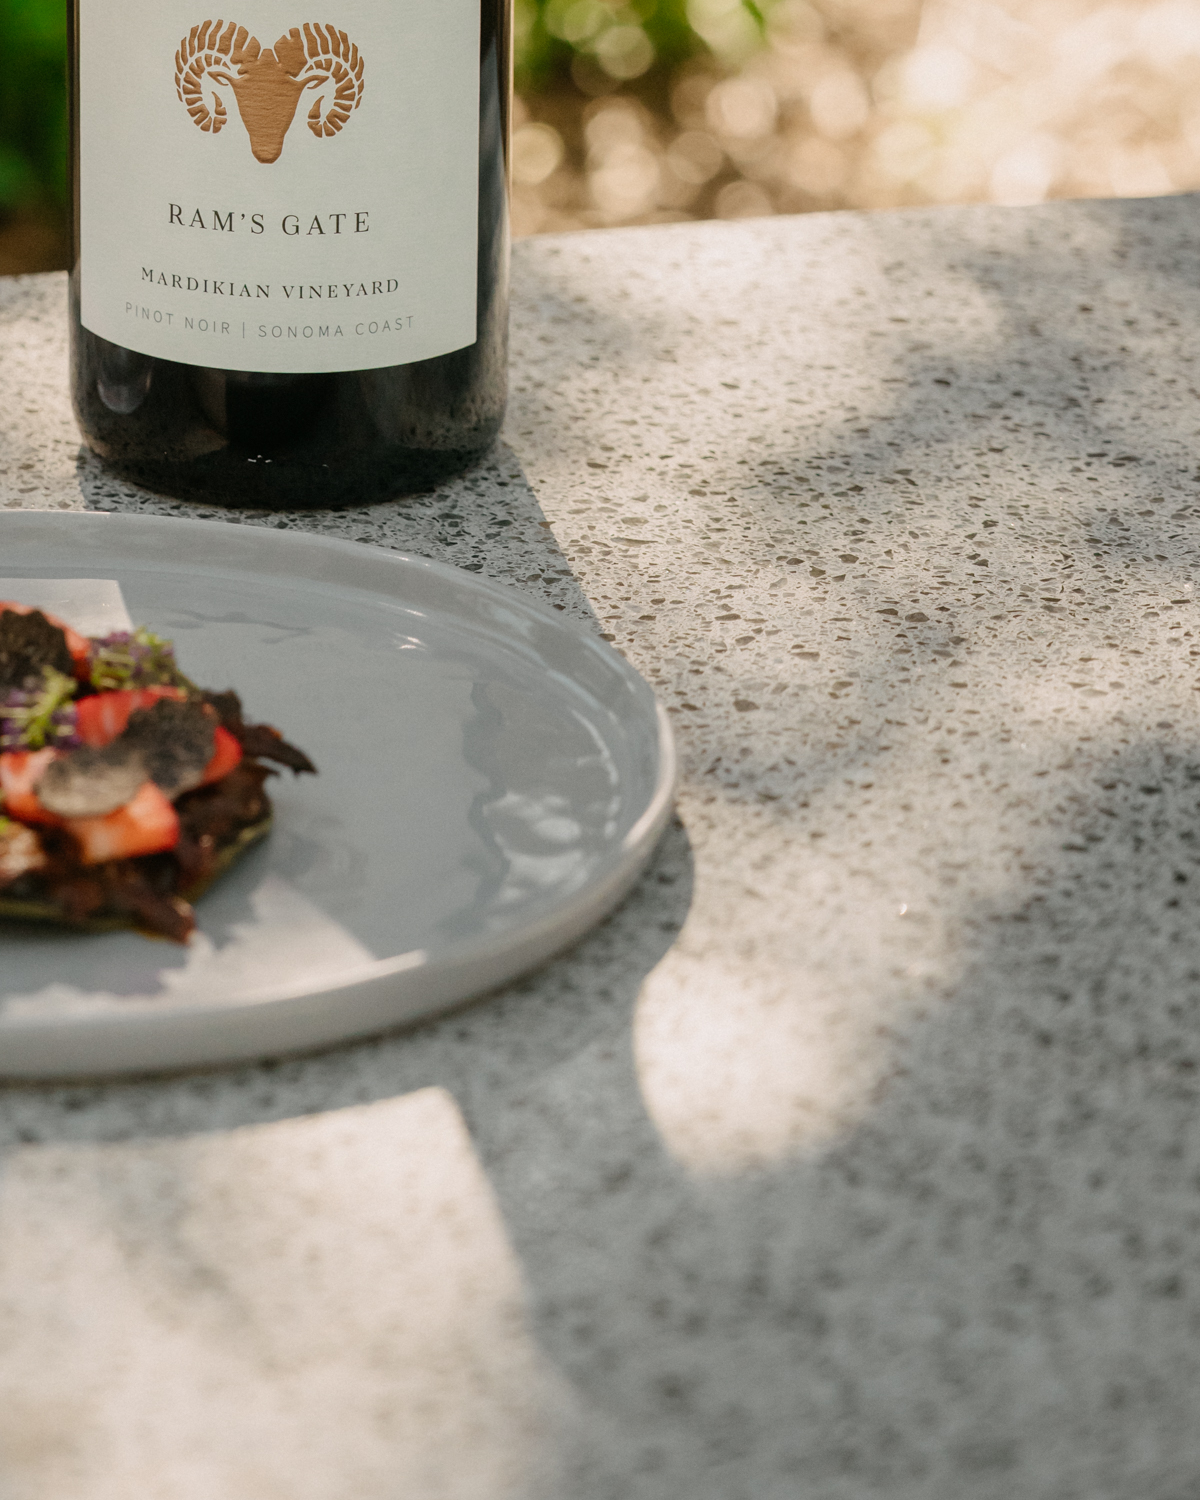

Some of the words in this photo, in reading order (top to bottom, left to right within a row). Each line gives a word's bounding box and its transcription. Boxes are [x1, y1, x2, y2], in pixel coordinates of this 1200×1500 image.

[281, 210, 372, 237] GATE
[141, 266, 272, 300] MARDIKIAN
[282, 277, 400, 300] VINEYARD
[125, 301, 175, 326] PINOT
[184, 316, 231, 336] NOIR
[258, 321, 345, 340] SONOMA
[355, 314, 416, 337] COAST
